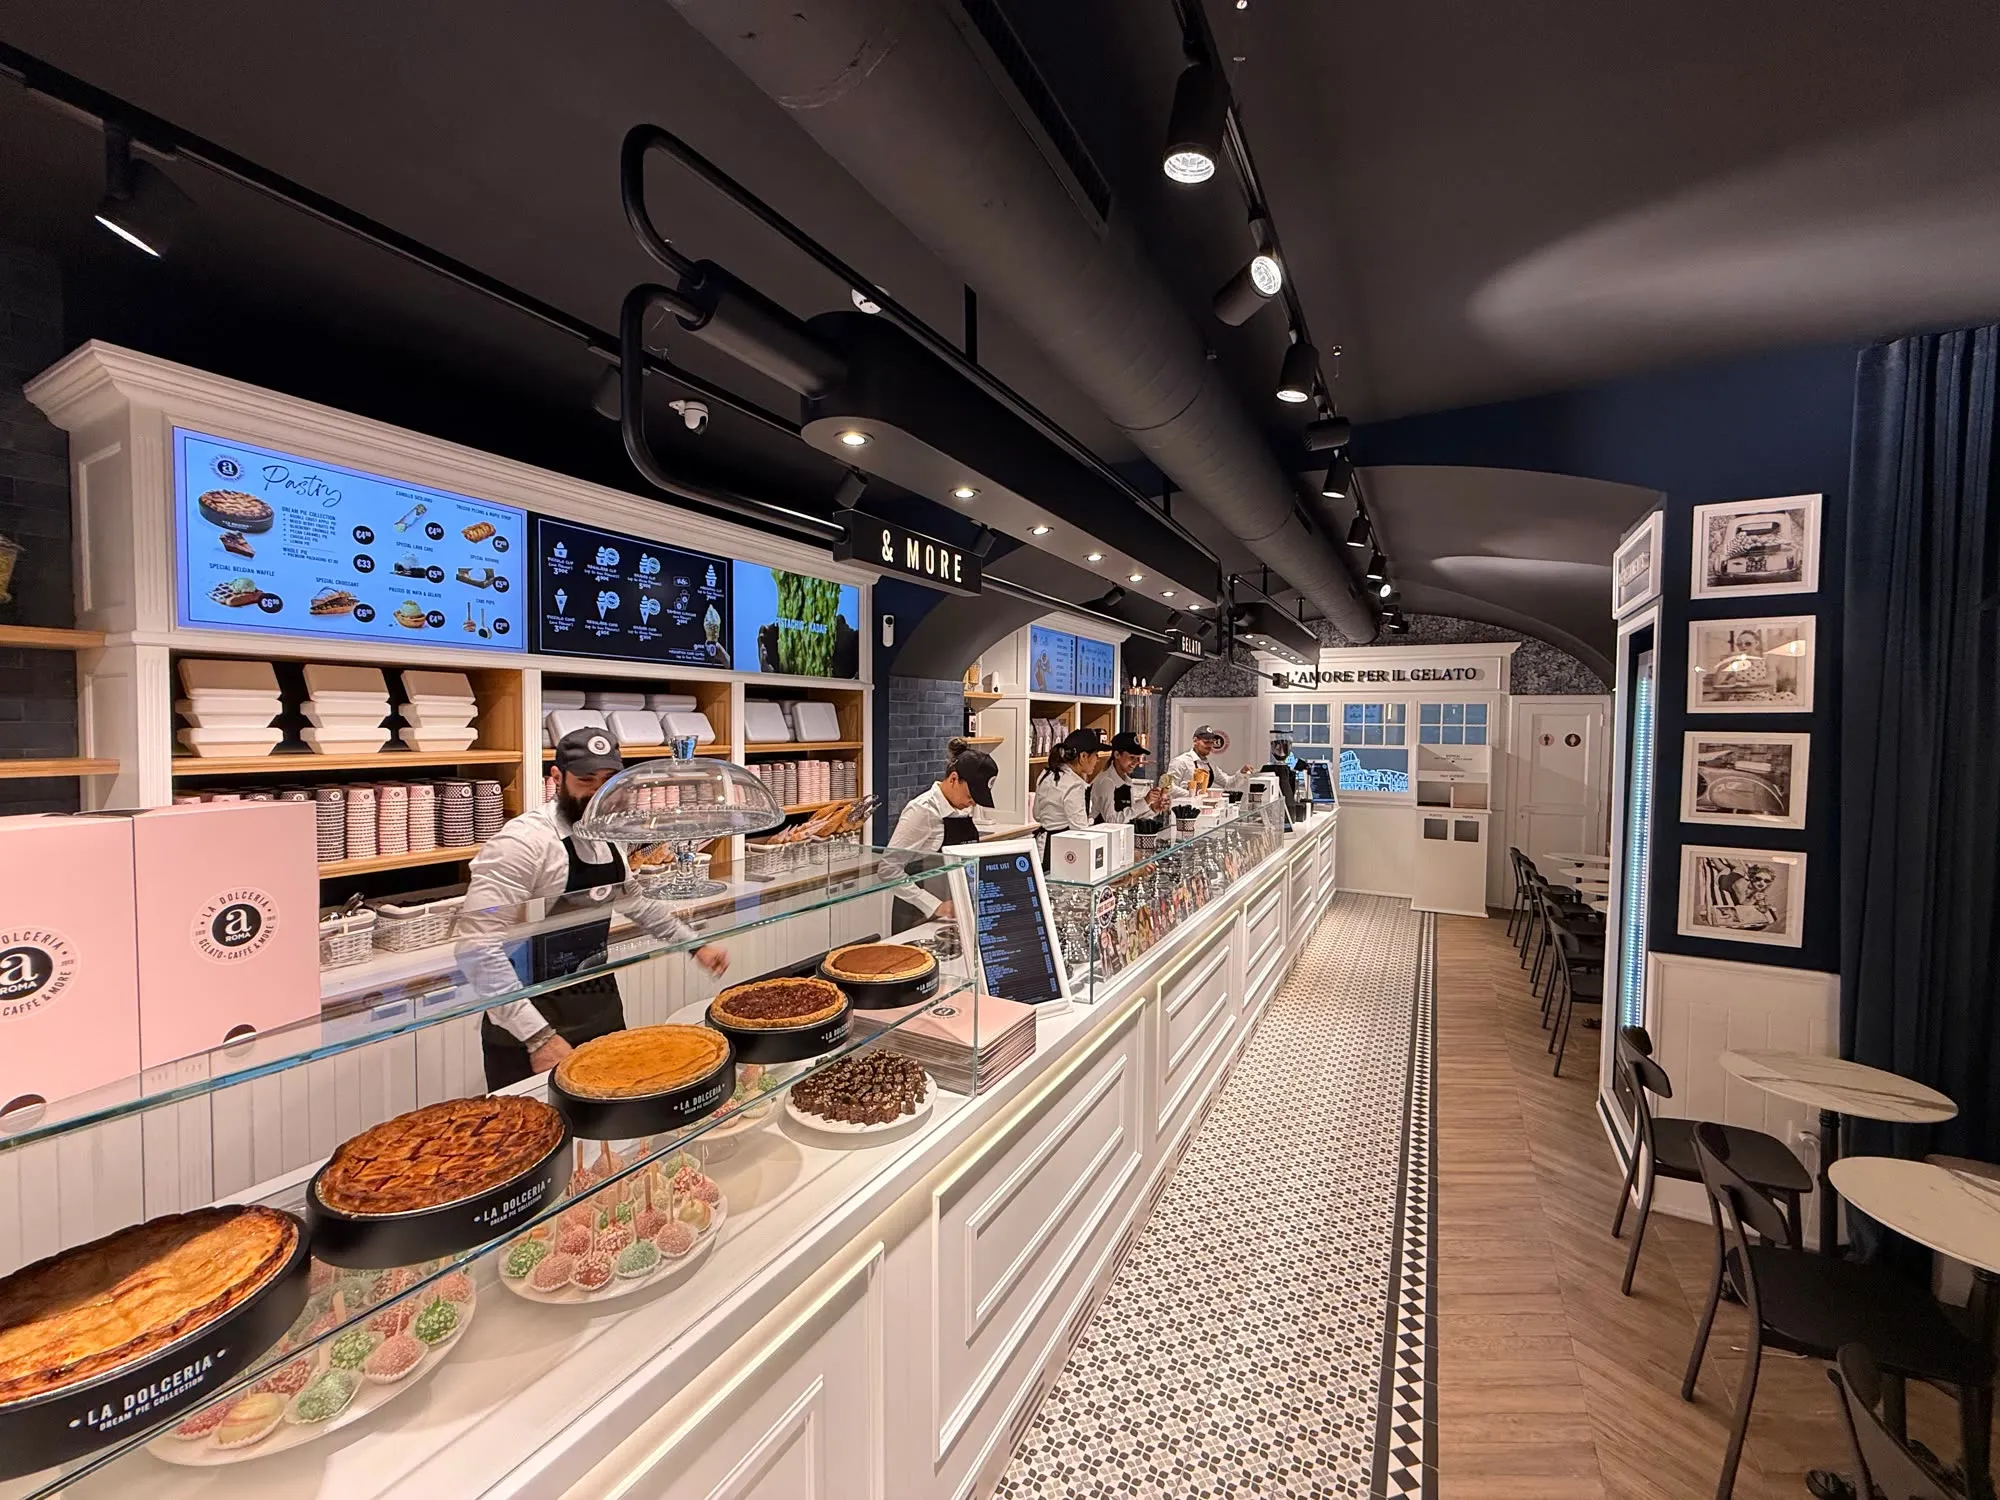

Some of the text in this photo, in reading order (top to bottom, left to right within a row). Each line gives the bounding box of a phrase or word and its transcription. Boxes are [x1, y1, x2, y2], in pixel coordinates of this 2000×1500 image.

[262, 465, 342, 508] Pastry
[208, 562, 275, 577] SPECIAL BELGIAN WAFFLE
[881, 529, 962, 583] & MORE
[315, 576, 334, 585] SPECIAL
[1181, 635, 1202, 656] GELATO
[1357, 669, 1387, 682] PER
[1391, 669, 1406, 682] IL
[1410, 667, 1478, 681] GELATO
[985, 862, 1010, 871] PRICE LIST
[202, 891, 270, 918] LA DOLCERIA
[225, 908, 252, 936] a
[258, 925, 274, 944] MORE
[1, 931, 64, 951] OLCERIA
[225, 931, 251, 942] ROMA
[3, 971, 72, 1017] CAFFE & MORE
[680, 1084, 722, 1111] LA DOLCERIA
[483, 1180, 546, 1222] LA DOLCERIA
[490, 1193, 542, 1227] DREAM PIE COLLECTION
[87, 1355, 213, 1426] LA DOLCERIA
[99, 1375, 204, 1431] DREAM PIE COLLECTION
